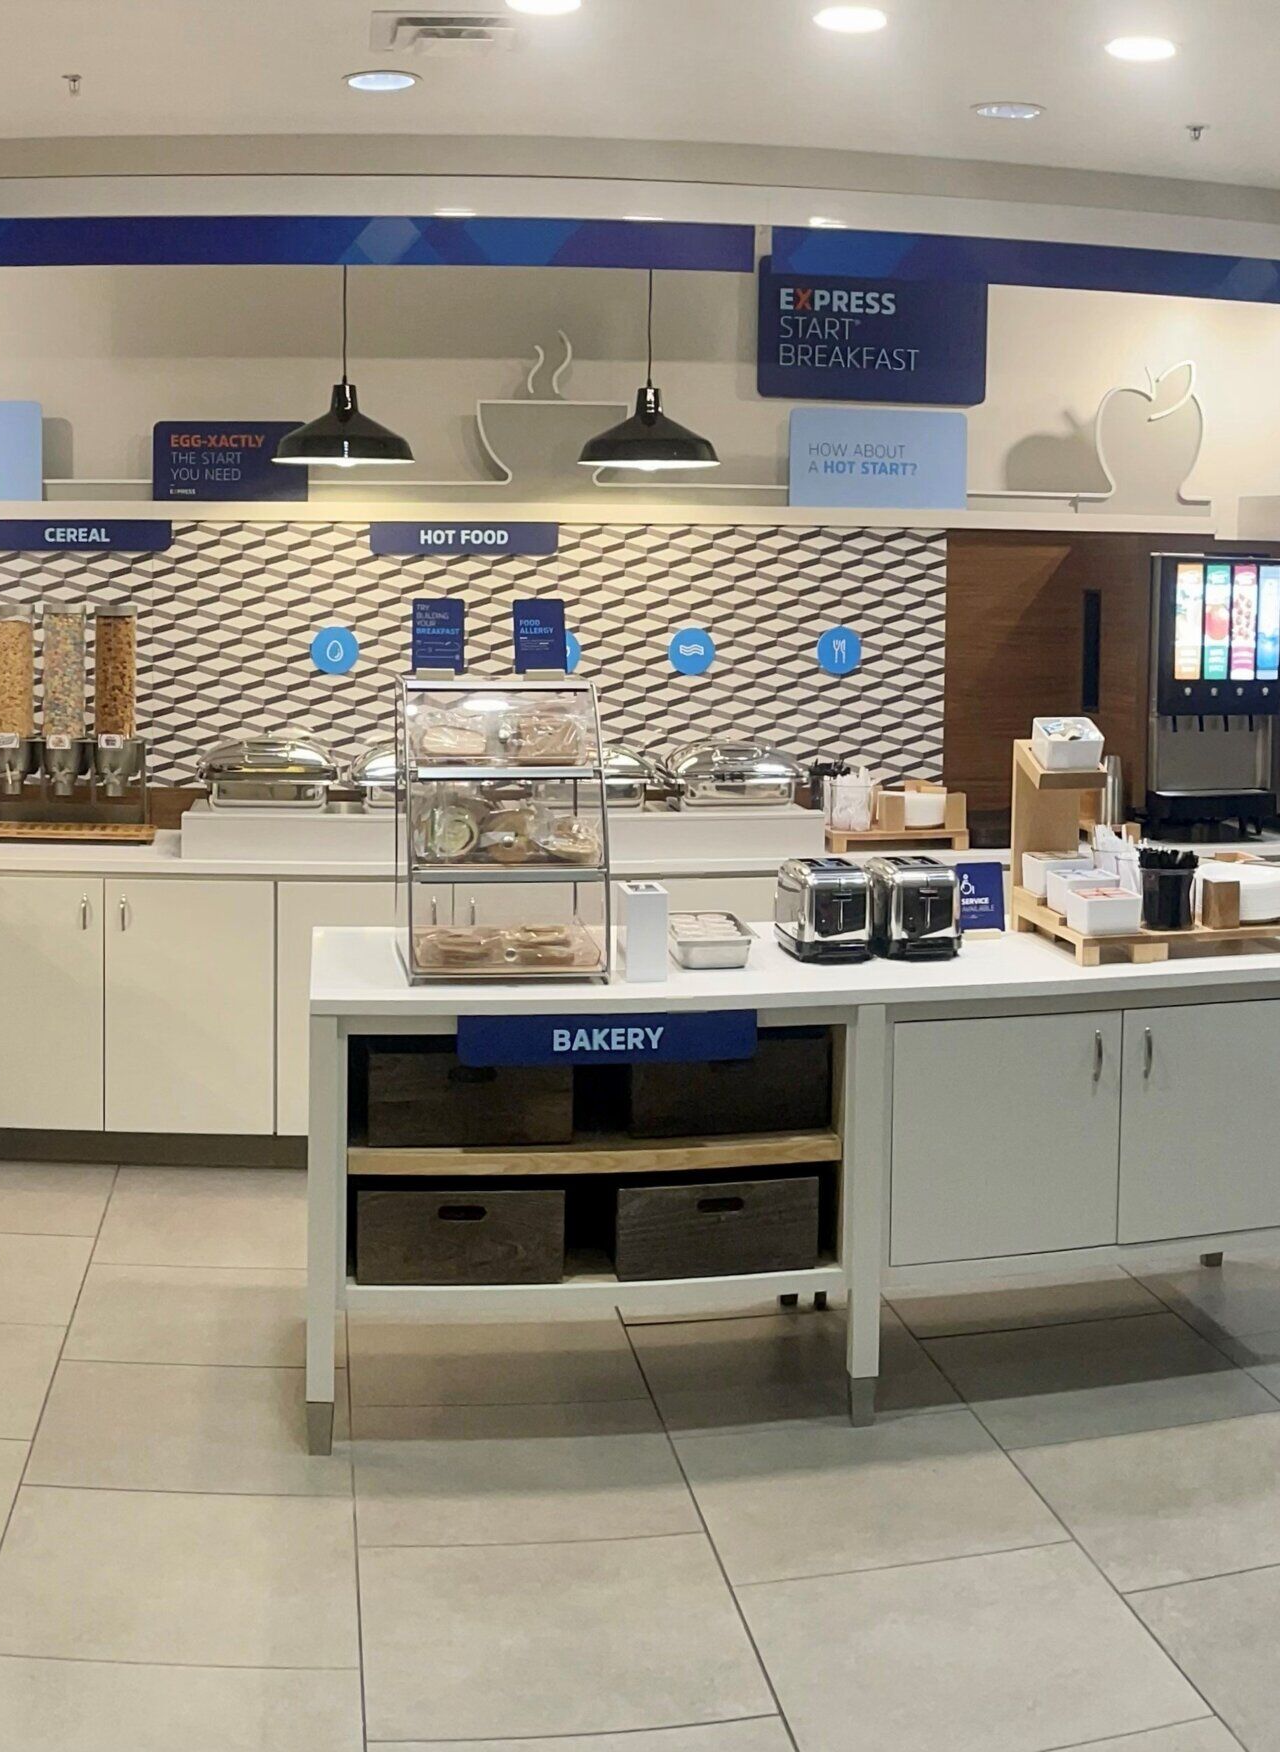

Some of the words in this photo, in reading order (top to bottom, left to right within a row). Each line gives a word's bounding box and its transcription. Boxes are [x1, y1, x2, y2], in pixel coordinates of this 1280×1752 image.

[780, 288, 896, 315] EXPRESS
[779, 343, 920, 371] BREAKFAST
[170, 434, 265, 448] EGG-XACTLY
[808, 442, 848, 457] HOW
[853, 443, 907, 459] ABOUT
[170, 451, 196, 465] THE
[201, 451, 242, 465] START
[170, 468, 200, 481] YOU
[204, 468, 242, 481] NEED
[808, 461, 819, 474] A
[823, 461, 856, 474] HOT
[861, 462, 918, 476] START?
[43, 527, 111, 543] CEREAL
[420, 529, 456, 545] HOT
[460, 529, 509, 545] FOOD
[416, 604, 430, 612] TRY
[519, 619, 541, 627] FOOD
[416, 627, 460, 635] BREAKFAST
[519, 627, 554, 635] ALLERGY
[961, 897, 989, 905] SERVICE
[553, 1026, 664, 1052] BAKERY
